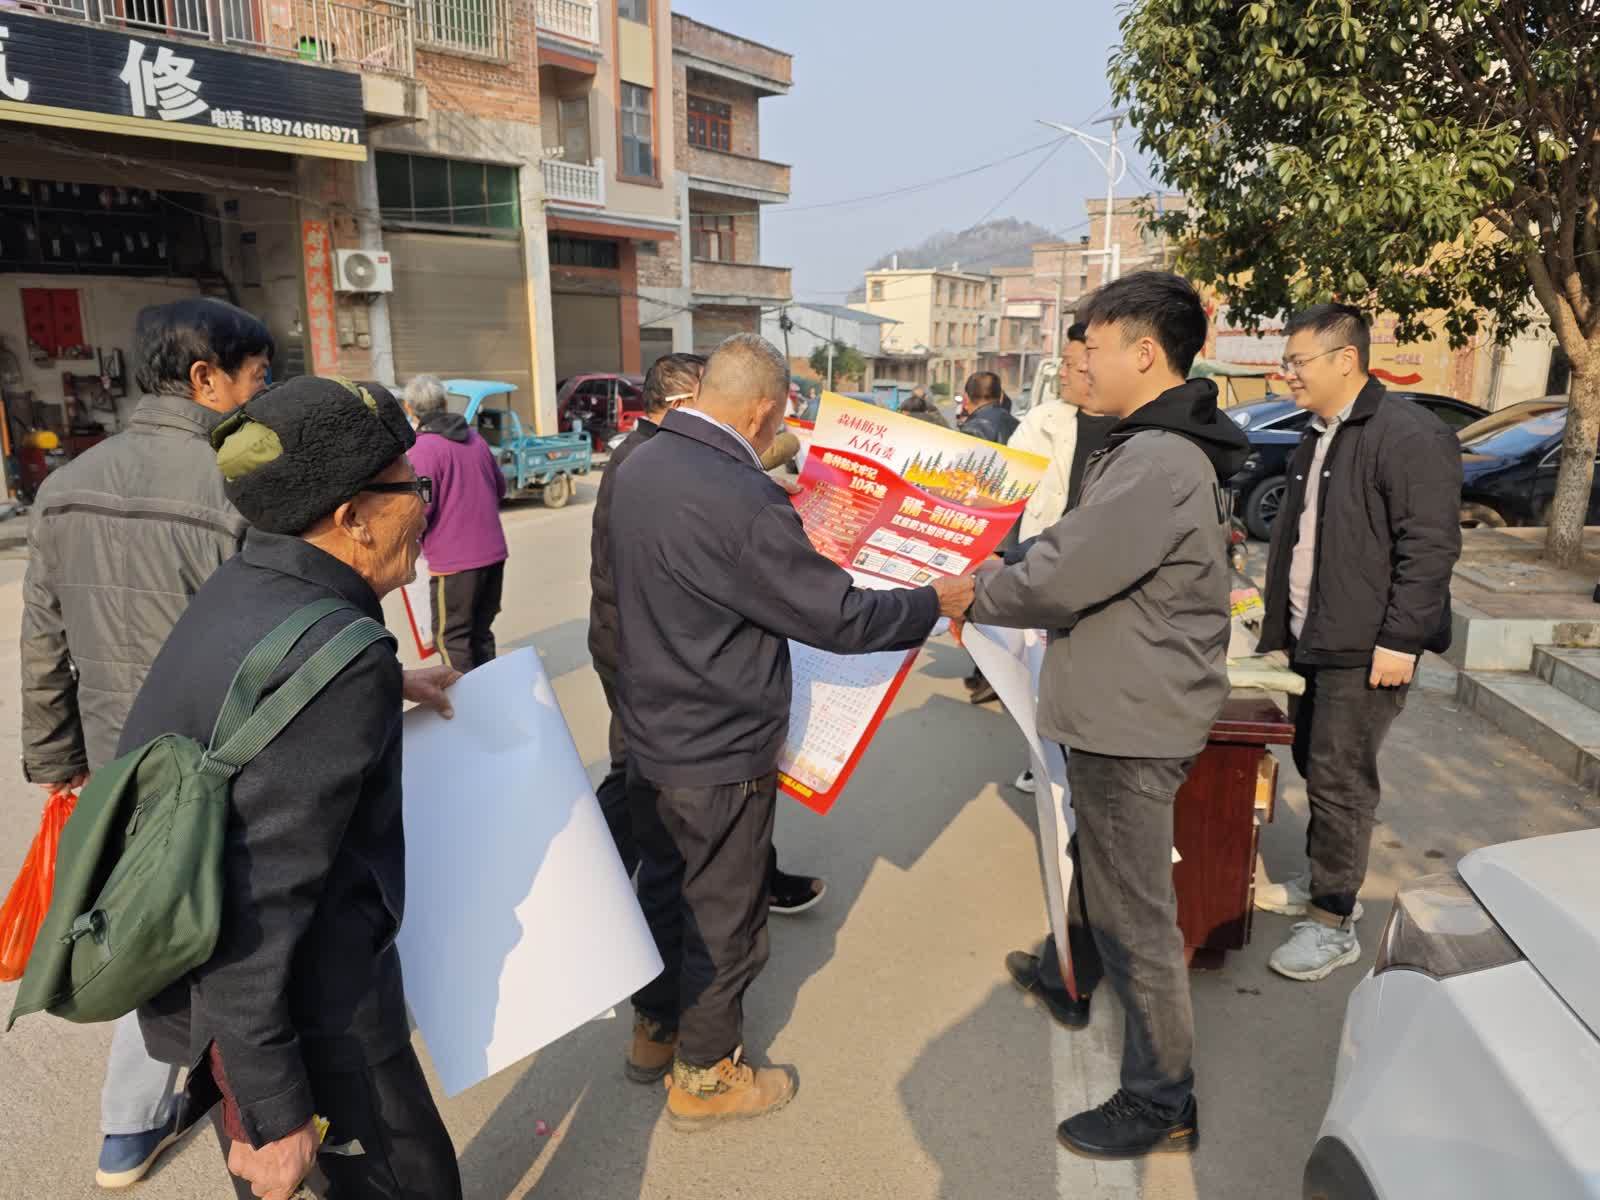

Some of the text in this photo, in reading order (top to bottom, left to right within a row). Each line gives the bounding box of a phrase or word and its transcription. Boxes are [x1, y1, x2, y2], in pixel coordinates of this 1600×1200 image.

[119, 39, 209, 121] 修
[838, 413, 887, 438] 森林防火
[847, 435, 895, 460] 人人有责
